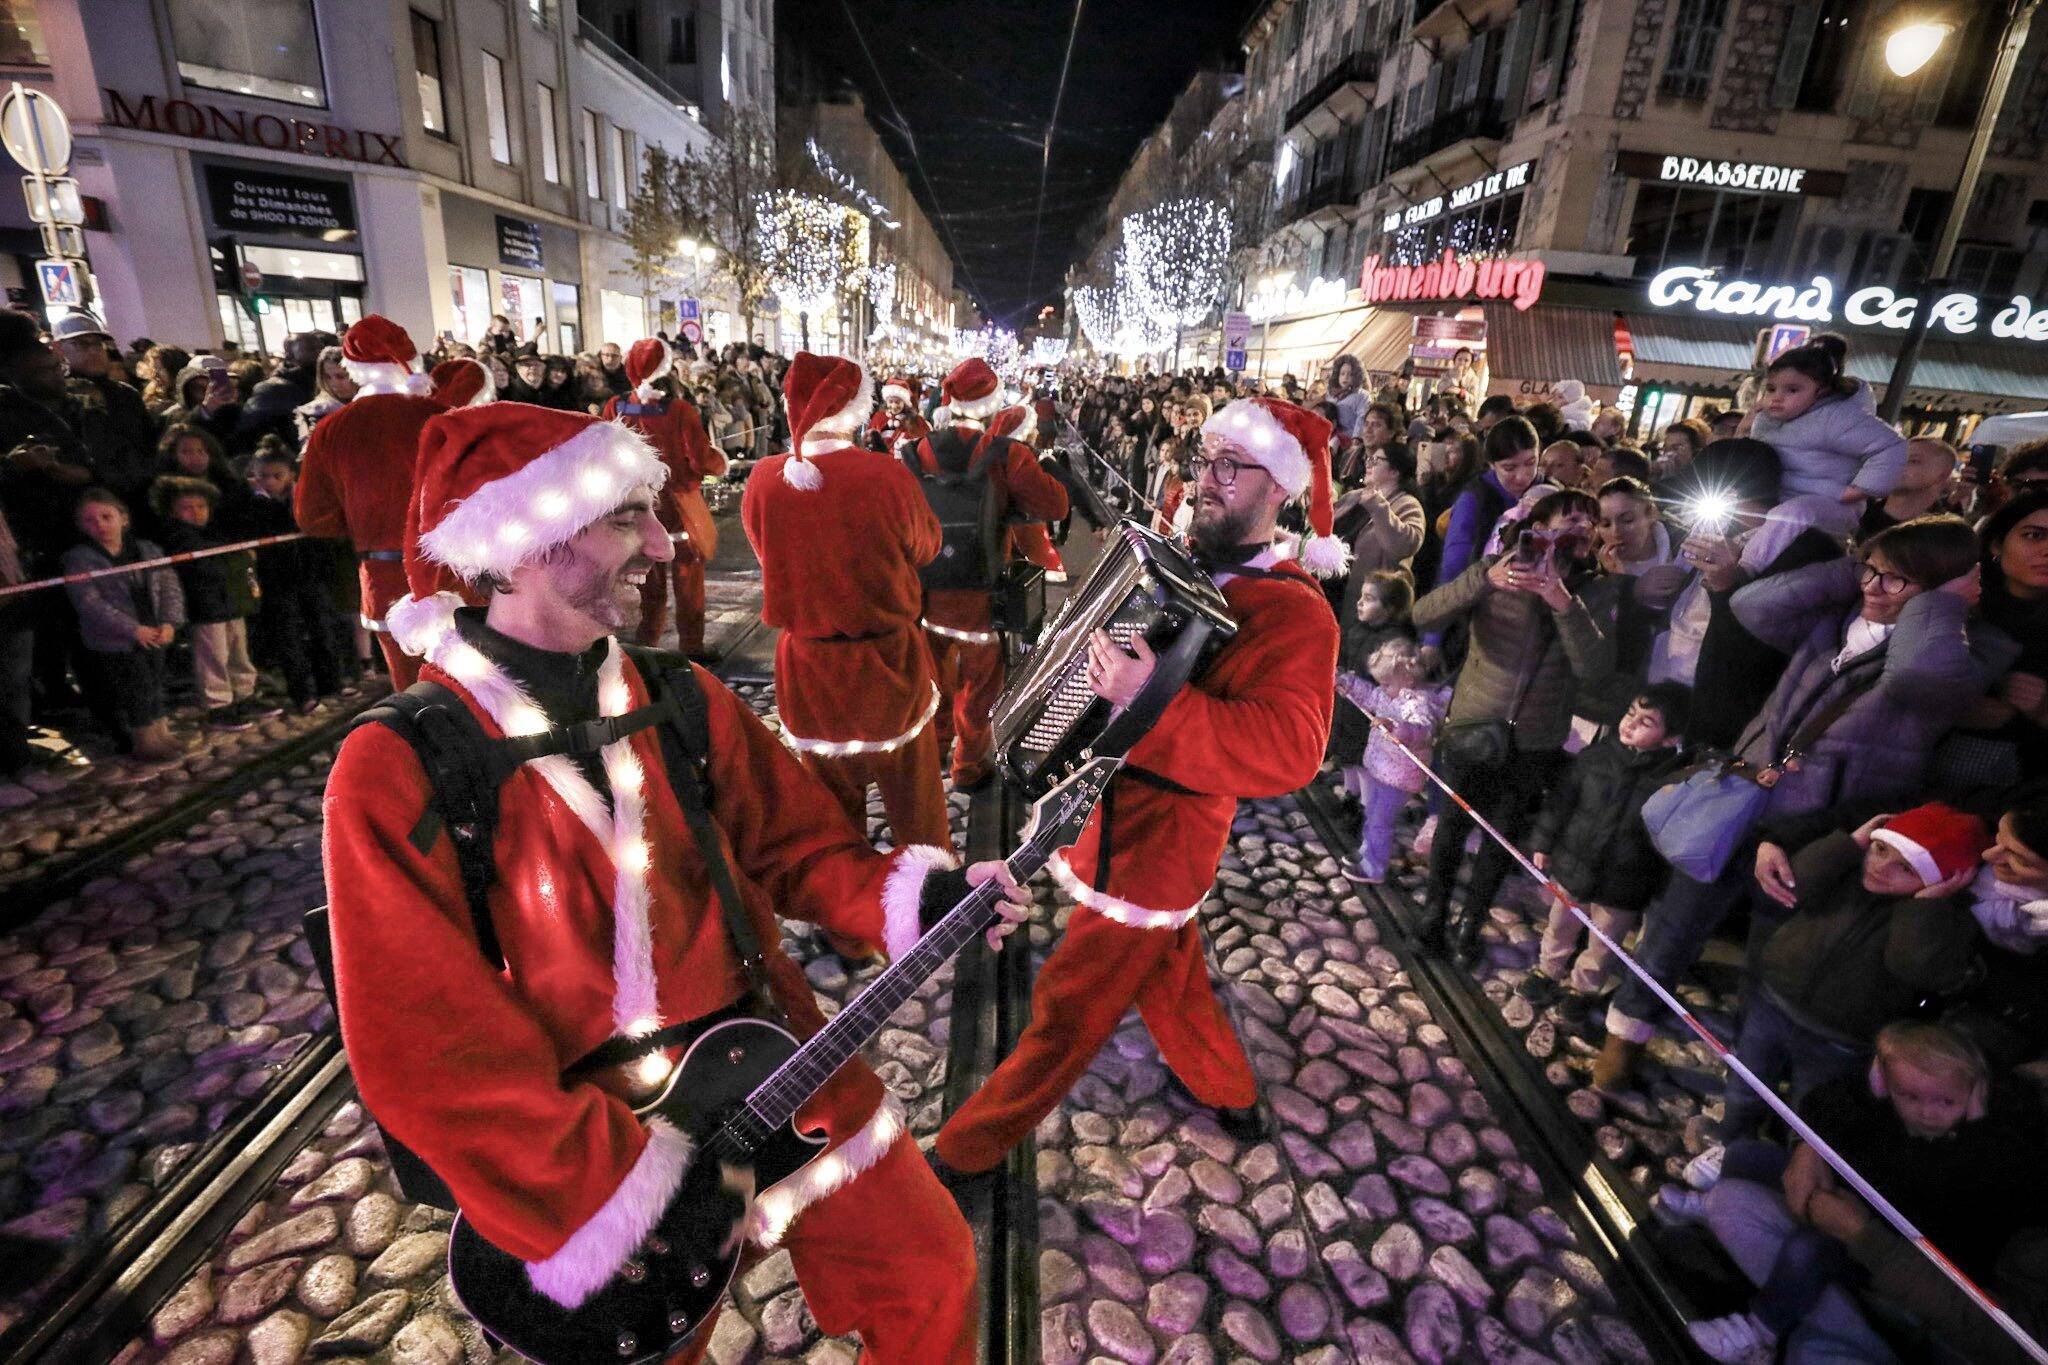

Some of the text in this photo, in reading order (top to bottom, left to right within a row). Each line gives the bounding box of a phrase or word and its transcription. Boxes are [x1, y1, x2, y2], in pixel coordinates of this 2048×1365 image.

[104, 87, 410, 169] MONOPRIX
[233, 180, 328, 202] Ouvert tous
[1660, 155, 1806, 194] BRASSERIE
[230, 207, 248, 220] de
[233, 194, 333, 216] les Dimanches
[1360, 247, 1546, 311] Kronenbourg
[1648, 265, 1833, 323] Grand
[1991, 294, 2048, 341] de
